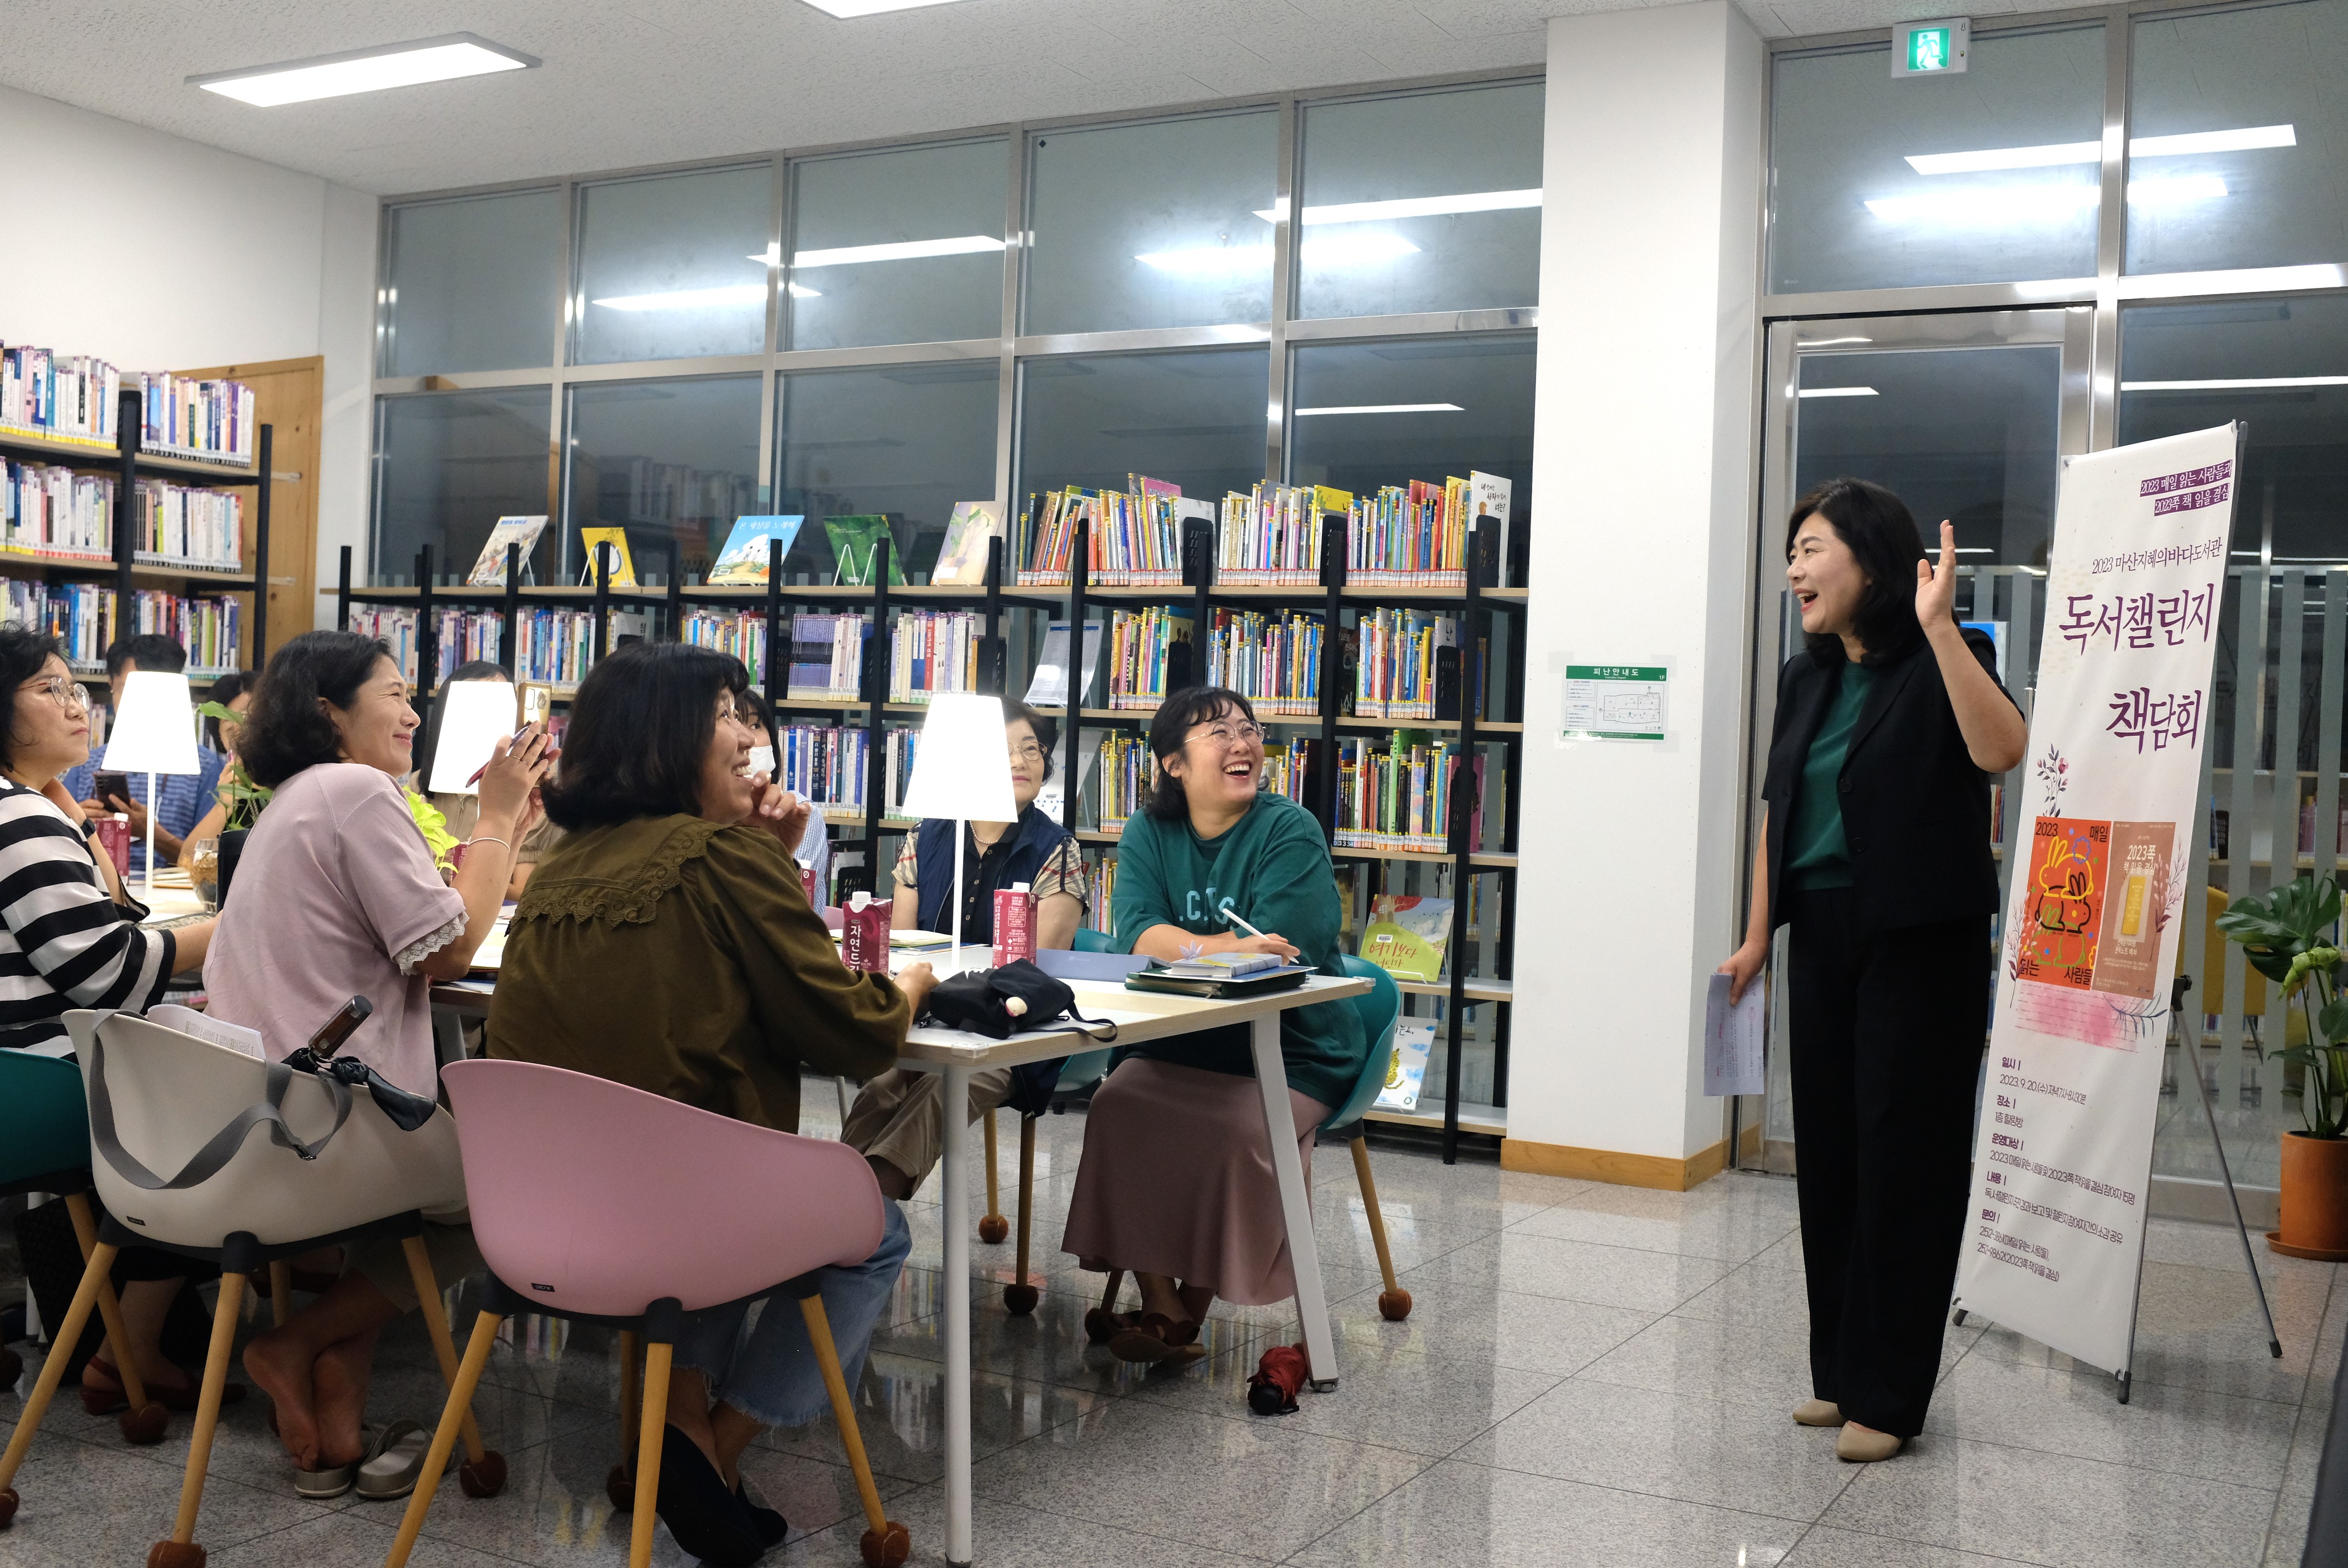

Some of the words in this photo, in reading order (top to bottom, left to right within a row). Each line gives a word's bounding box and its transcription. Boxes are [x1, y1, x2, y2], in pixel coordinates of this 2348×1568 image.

[2141, 479, 2159, 494] 2023
[2161, 474, 2177, 491] 매일
[2180, 472, 2196, 488] 읽는
[2198, 460, 2232, 483] 사람들과
[2155, 496, 2180, 513] 2023쪽
[2182, 493, 2191, 508] 책
[2195, 490, 2211, 507] 읽을
[2213, 483, 2230, 502] 결심
[1495, 502, 1505, 512] 너는?
[772, 521, 796, 529] 노래해
[2092, 557, 2113, 574] 2023
[2115, 537, 2222, 573] 마산지혜의바다도서관
[2058, 583, 2215, 656] 독서챌린지
[2106, 687, 2202, 755] 책담회
[2036, 822, 2058, 837] 2023
[2090, 825, 2108, 842] 매일
[2127, 845, 2156, 863] 2023쪽
[2123, 862, 2129, 874] 책
[1369, 942, 1418, 958] 여기보다
[2020, 958, 2040, 977] 읽는
[2064, 966, 2093, 986] 사람들
[2002, 1057, 2016, 1069] 일시
[2000, 1074, 2019, 1087] 2023.
[1997, 1095, 2011, 1108] 장소
[1995, 1112, 2004, 1123] 1층
[2004, 1113, 2023, 1128] 힐링방
[1992, 1133, 2019, 1149] 운영대상
[1986, 1170, 2001, 1184] 내용
[1990, 1150, 2009, 1164] 2023
[2009, 1154, 2022, 1168] 매일
[2021, 1158, 2031, 1171] 읽는
[2048, 1168, 2074, 1184] 2023쪽
[2090, 1180, 2104, 1195] 결심
[2104, 1184, 2122, 1200] 참여자
[2122, 1190, 2135, 1205] 15명
[1981, 1209, 1996, 1222] 문의
[2031, 1203, 2045, 1217] 보고
[2109, 1230, 2123, 1245] 공유
[2018, 1239, 2031, 1253] 읽는
